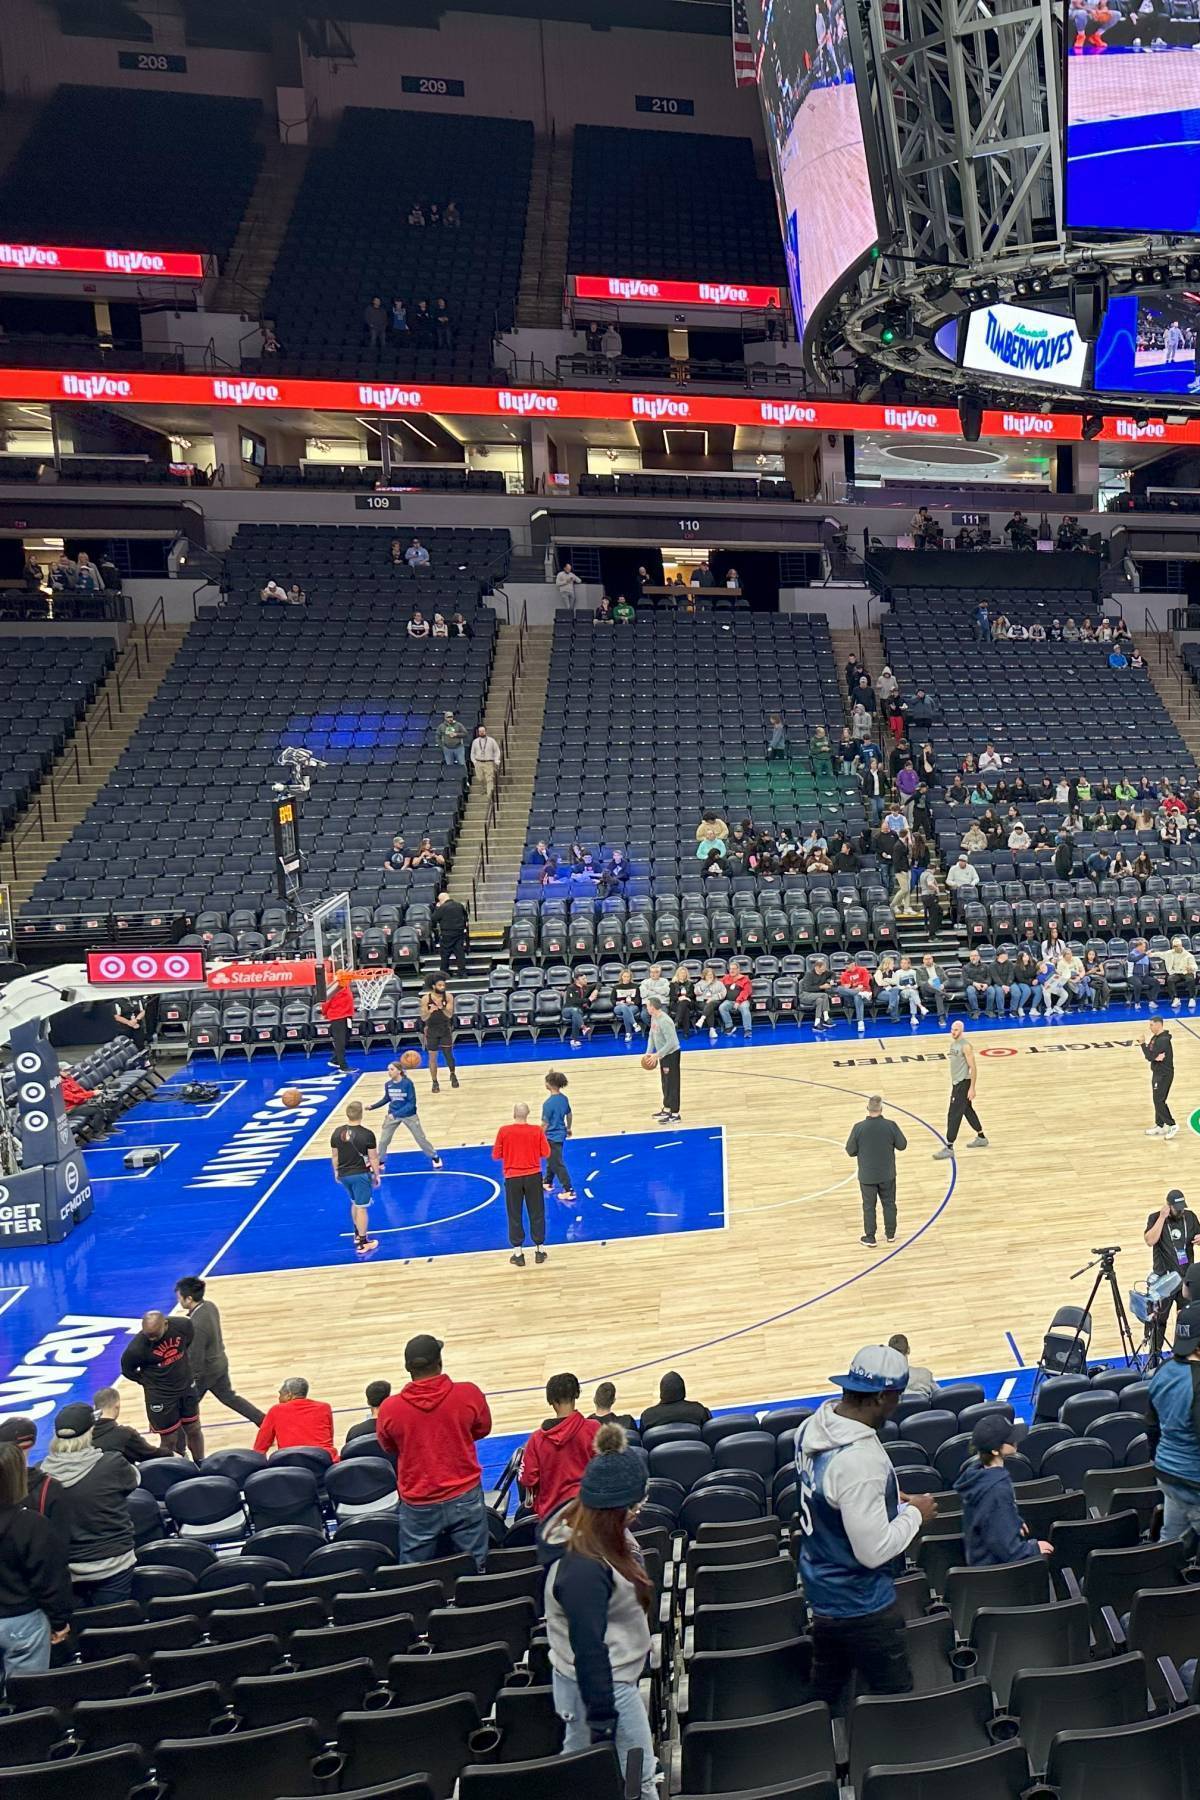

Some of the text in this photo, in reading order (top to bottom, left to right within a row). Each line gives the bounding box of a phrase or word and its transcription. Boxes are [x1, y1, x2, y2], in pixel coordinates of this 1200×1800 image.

[138, 54, 168, 71] 208
[419, 77, 447, 95] 209
[651, 98, 678, 115] 210
[105, 251, 164, 273] HyVee
[608, 279, 659, 299] HyVee
[698, 284, 749, 303] HyVee
[985, 309, 1074, 371] TIMBERWOLVES
[63, 375, 130, 400] HyVee
[213, 380, 279, 404] HyVee
[359, 386, 421, 408] HyVee
[498, 391, 558, 414] HyVee
[632, 397, 689, 419] HyVee
[761, 402, 816, 425] HyVee
[884, 408, 937, 429] HyVee
[1003, 414, 1054, 434] HyVee
[367, 497, 390, 509] 109
[678, 521, 700, 531] 110
[961, 514, 980, 525] 111
[833, 1051, 951, 1067] ENTER
[0, 1203, 41, 1220] GET
[60, 1186, 91, 1221] CFMOTO
[0, 1218, 42, 1235] TER
[152, 1336, 181, 1357] BULLS
